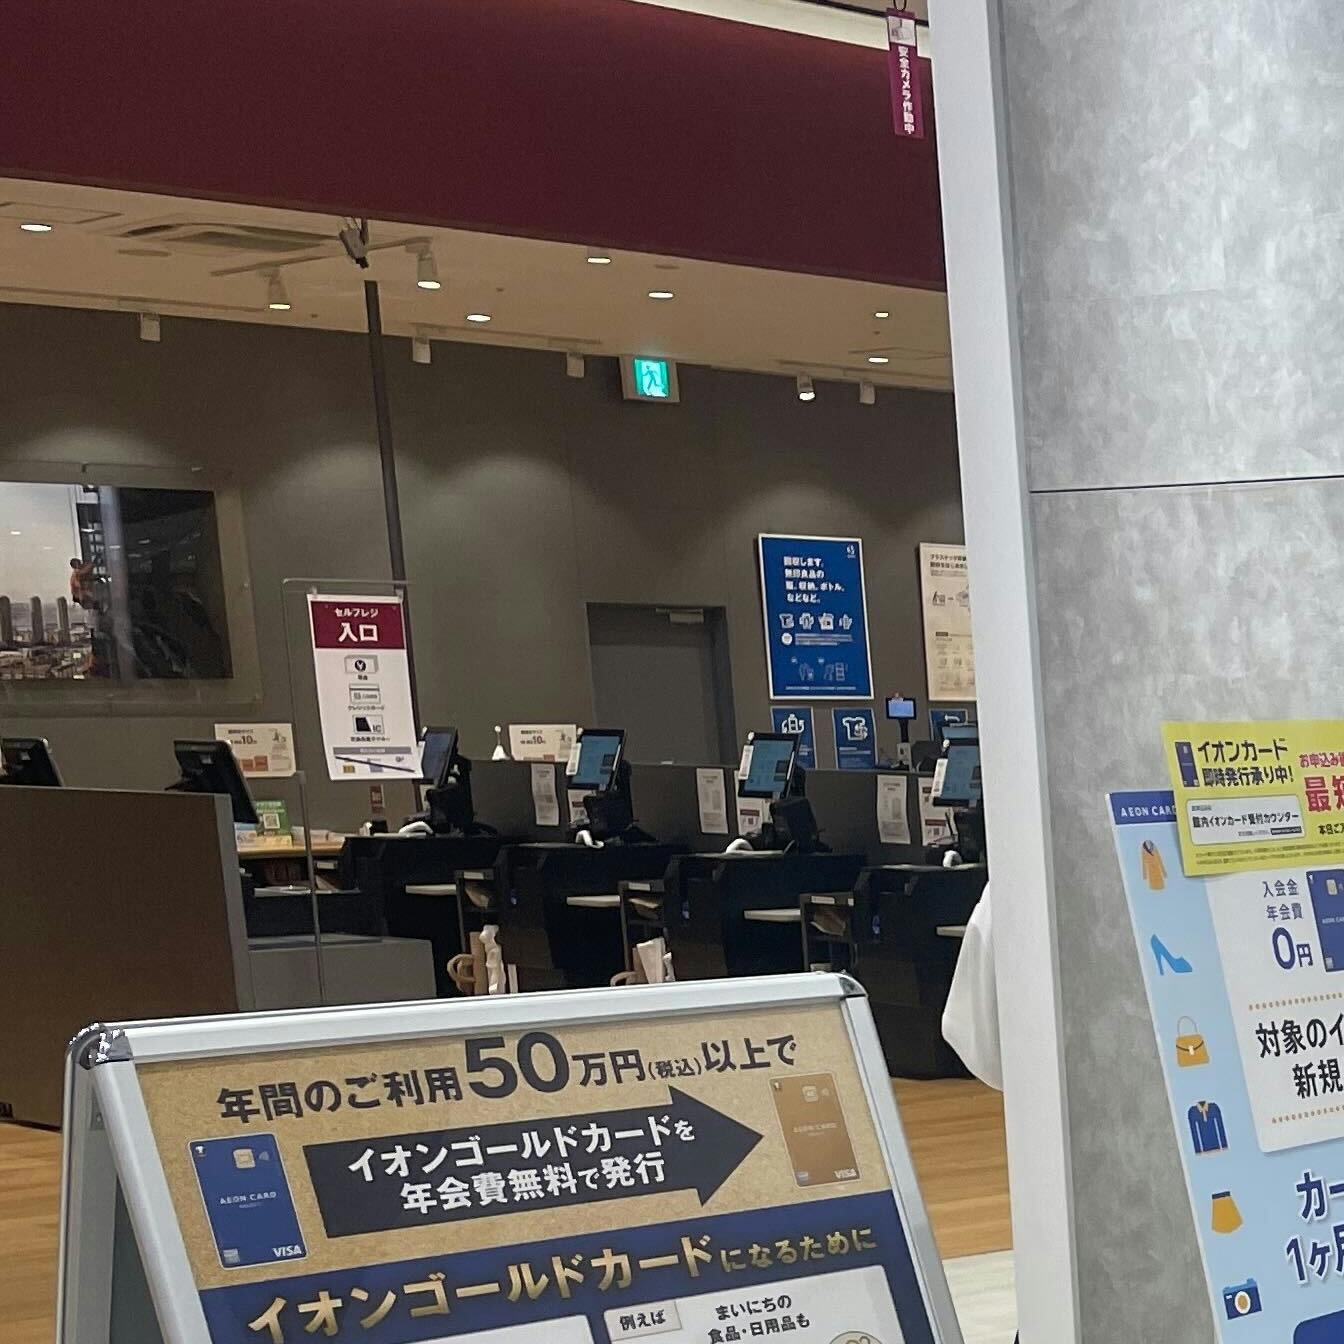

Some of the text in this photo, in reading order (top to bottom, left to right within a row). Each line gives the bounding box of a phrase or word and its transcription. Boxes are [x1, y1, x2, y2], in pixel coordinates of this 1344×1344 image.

[335, 608, 379, 618] セルフレジ
[338, 622, 379, 642] 入口
[1198, 739, 1289, 763] イオンカード
[1121, 805, 1149, 817] AEON
[1262, 879, 1300, 897] 入会金
[1266, 903, 1304, 921] 年会費
[1272, 926, 1314, 970] 0円
[217, 1032, 797, 1124] 年間のご利用50万円(税込)以上で
[349, 1115, 696, 1182] イオンゴールドカードを
[401, 1151, 665, 1215] 年会費無料で発行
[273, 1245, 302, 1257] VISA
[248, 1228, 878, 1344] イオンゴールドカードになるために
[715, 1294, 793, 1321] まいにちの
[620, 1309, 667, 1331] 例えば
[708, 1313, 811, 1344] 食品・日用品も
